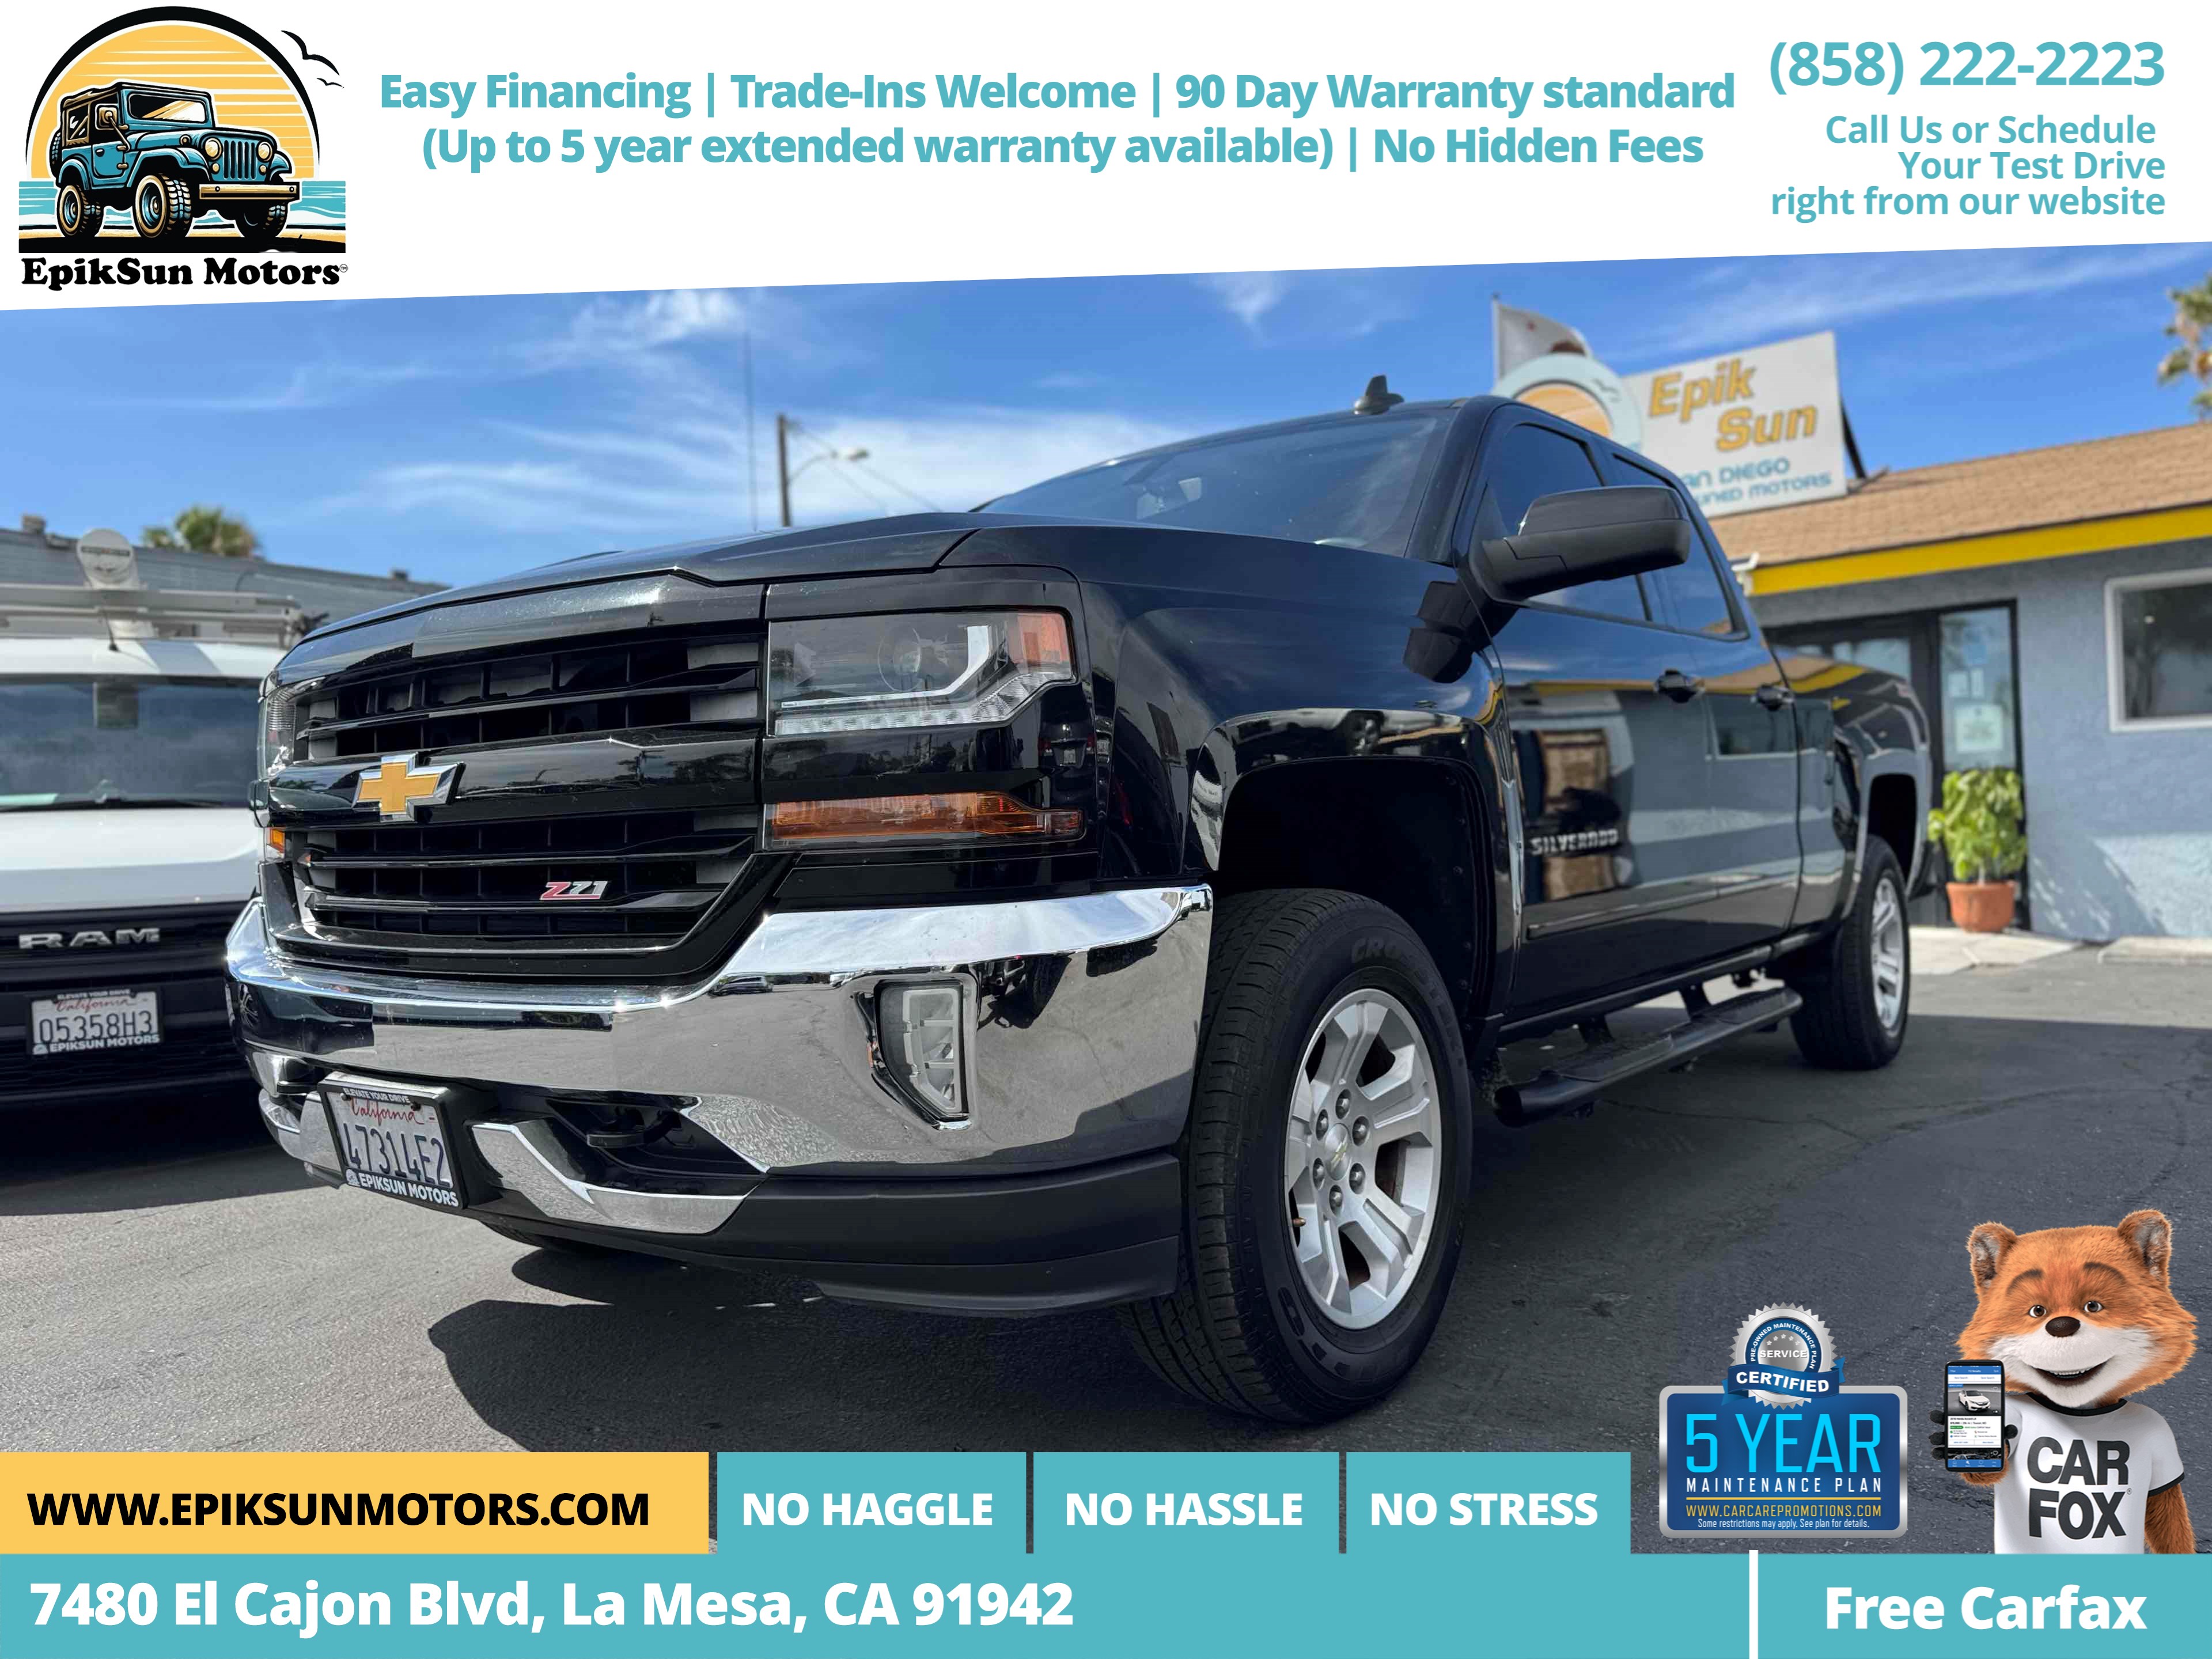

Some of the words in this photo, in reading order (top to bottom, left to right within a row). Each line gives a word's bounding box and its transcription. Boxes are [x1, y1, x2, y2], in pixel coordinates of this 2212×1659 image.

[1647, 358, 1757, 423] Epik
[1715, 406, 1818, 452] Sun
[1718, 456, 1790, 485] DIEGO
[1530, 828, 1618, 855] SILVERADO
[540, 881, 608, 900] Z71
[18, 927, 161, 949] RAM
[56, 998, 137, 1013] California
[50, 1037, 105, 1053] EPIKSUN
[107, 1034, 160, 1048] MOTORS
[350, 1097, 425, 1126] California
[358, 1173, 407, 1196] EPIKSUN
[408, 1183, 460, 1207] MOTORS
